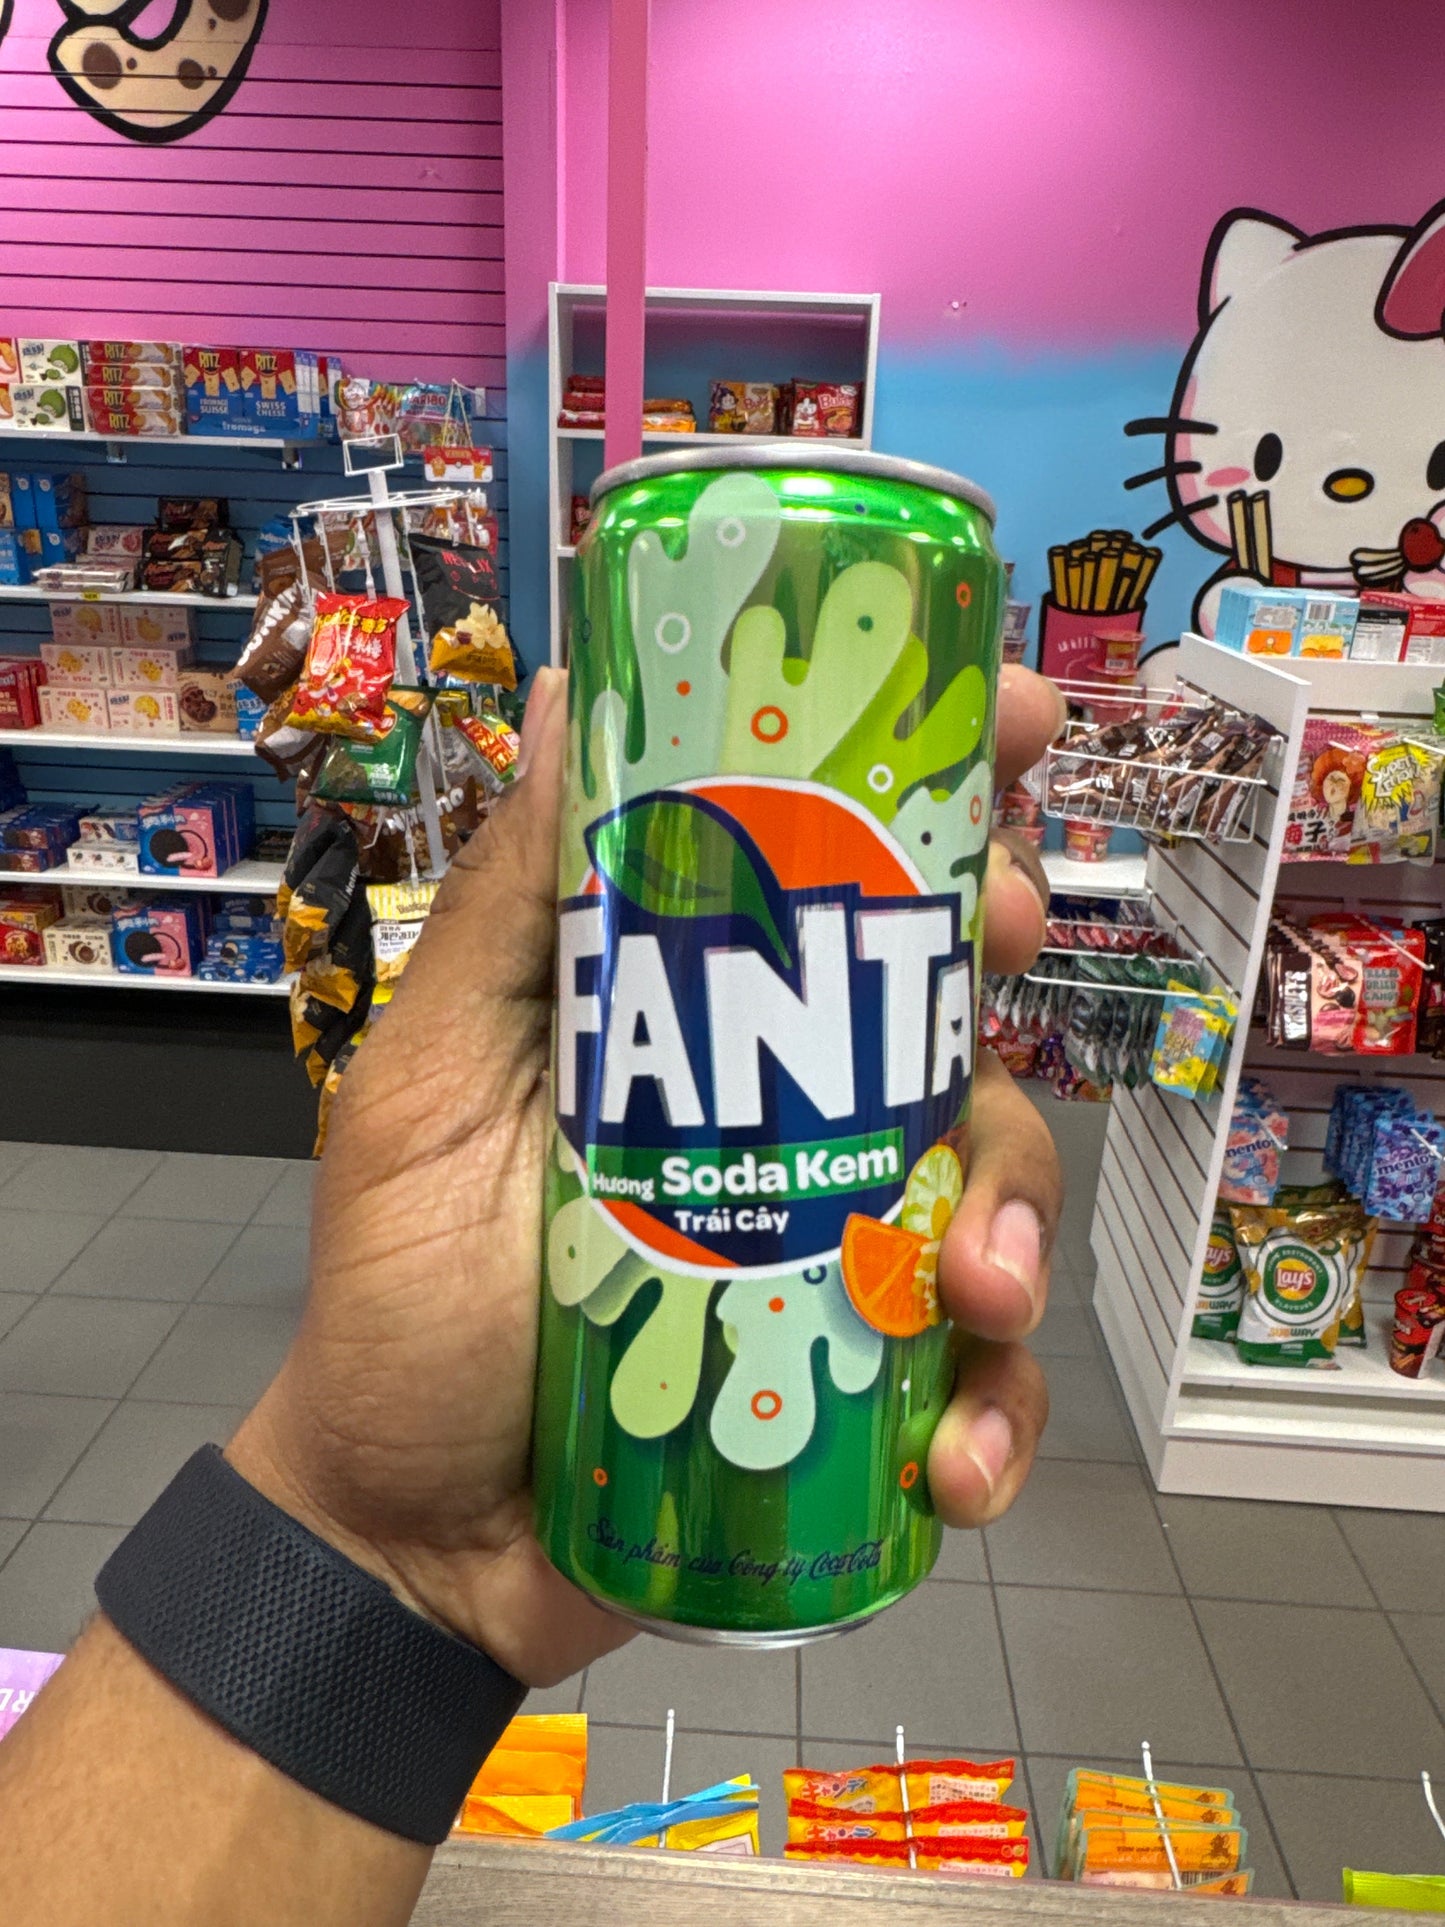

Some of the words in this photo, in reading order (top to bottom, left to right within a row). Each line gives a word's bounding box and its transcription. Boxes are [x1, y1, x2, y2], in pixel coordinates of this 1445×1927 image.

[105, 343, 127, 359] RITZ
[198, 351, 220, 368] RITZ
[255, 353, 278, 370] RITZ
[103, 366, 125, 381] RITZ
[103, 389, 125, 403] RITZ
[408, 392, 447, 405] ARIBO
[255, 400, 287, 409] SWISS
[109, 413, 130, 428] RITZ
[441, 549, 494, 574] NETIX
[1365, 980, 1396, 990] DRIED
[558, 903, 972, 1128] FANTA
[661, 1152, 788, 1198] Soda
[795, 1145, 899, 1190] Kem
[674, 1208, 731, 1233] Trái
[736, 1208, 790, 1234] Cây
[1268, 1327, 1320, 1338] SUBWAY
